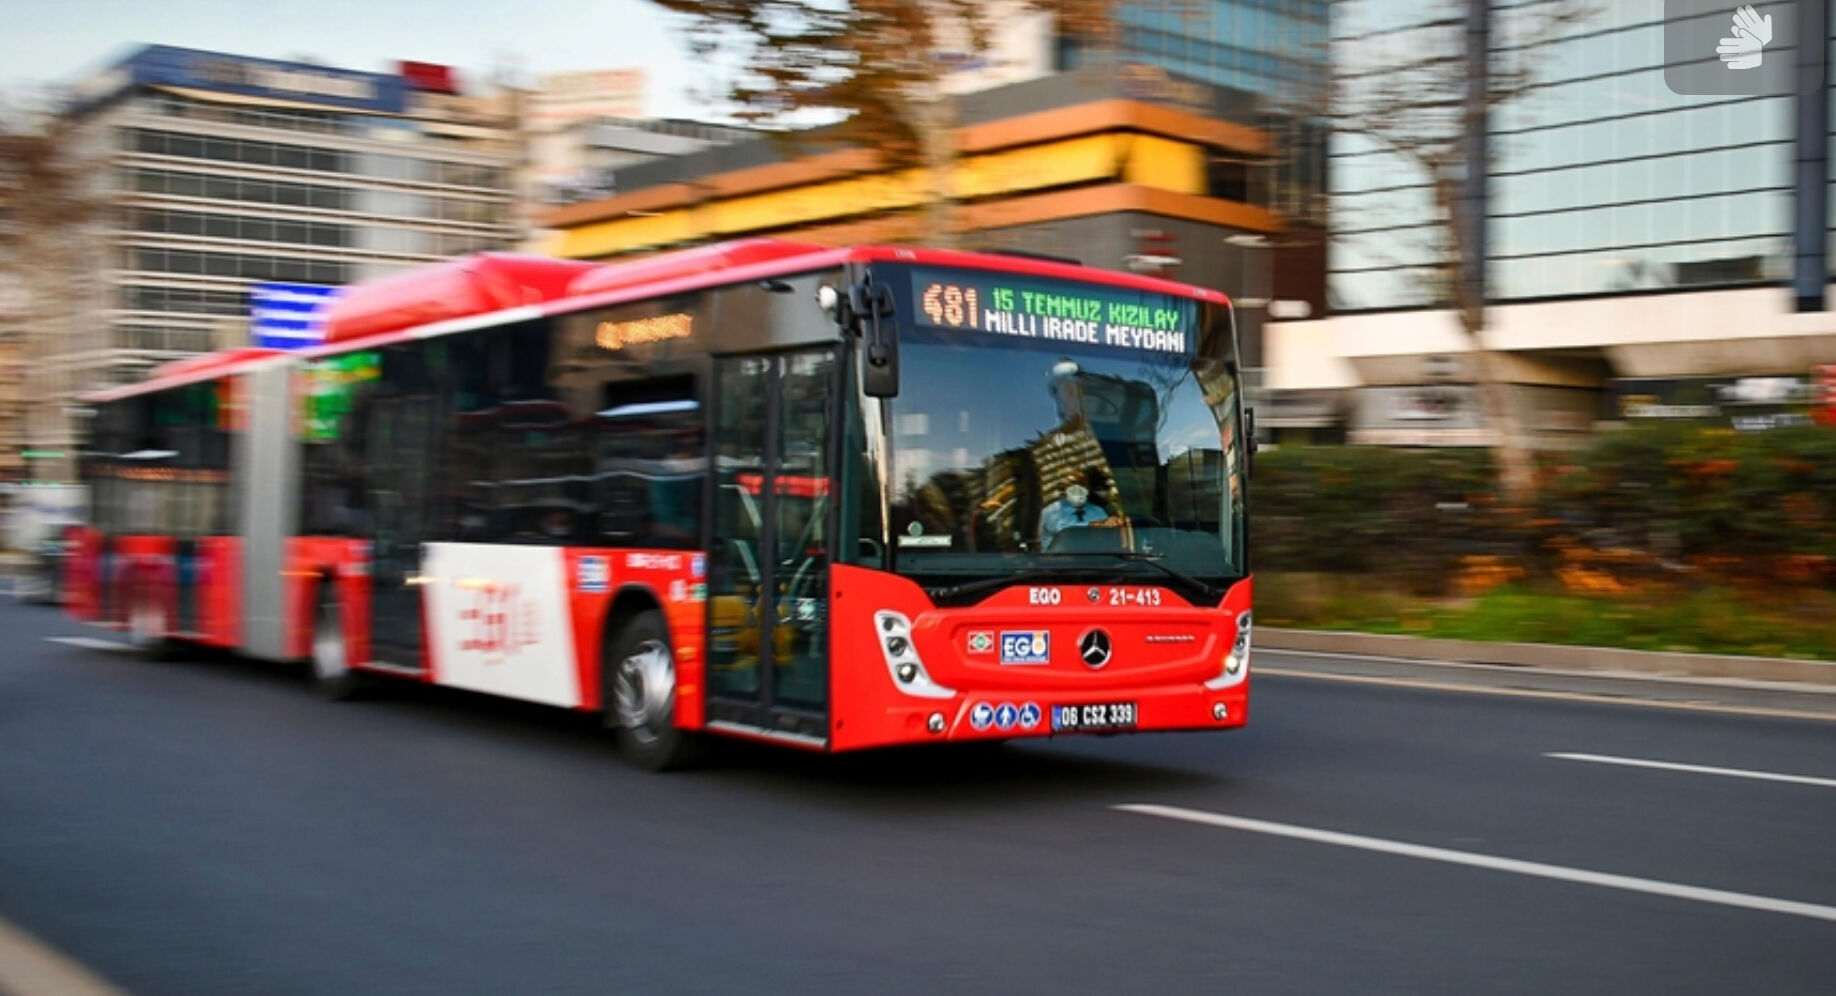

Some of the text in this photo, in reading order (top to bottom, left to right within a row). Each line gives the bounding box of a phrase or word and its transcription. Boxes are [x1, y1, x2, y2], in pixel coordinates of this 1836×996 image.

[923, 283, 978, 328] 481
[993, 287, 1179, 331] 15 TEMMUZ KIZILAY
[1106, 323, 1185, 353] MEYDANI
[1029, 587, 1061, 605] EGO
[1110, 587, 1161, 606] 21-413
[1004, 636, 1046, 656] EGO
[1061, 703, 1132, 726] 06 CSZ 339
